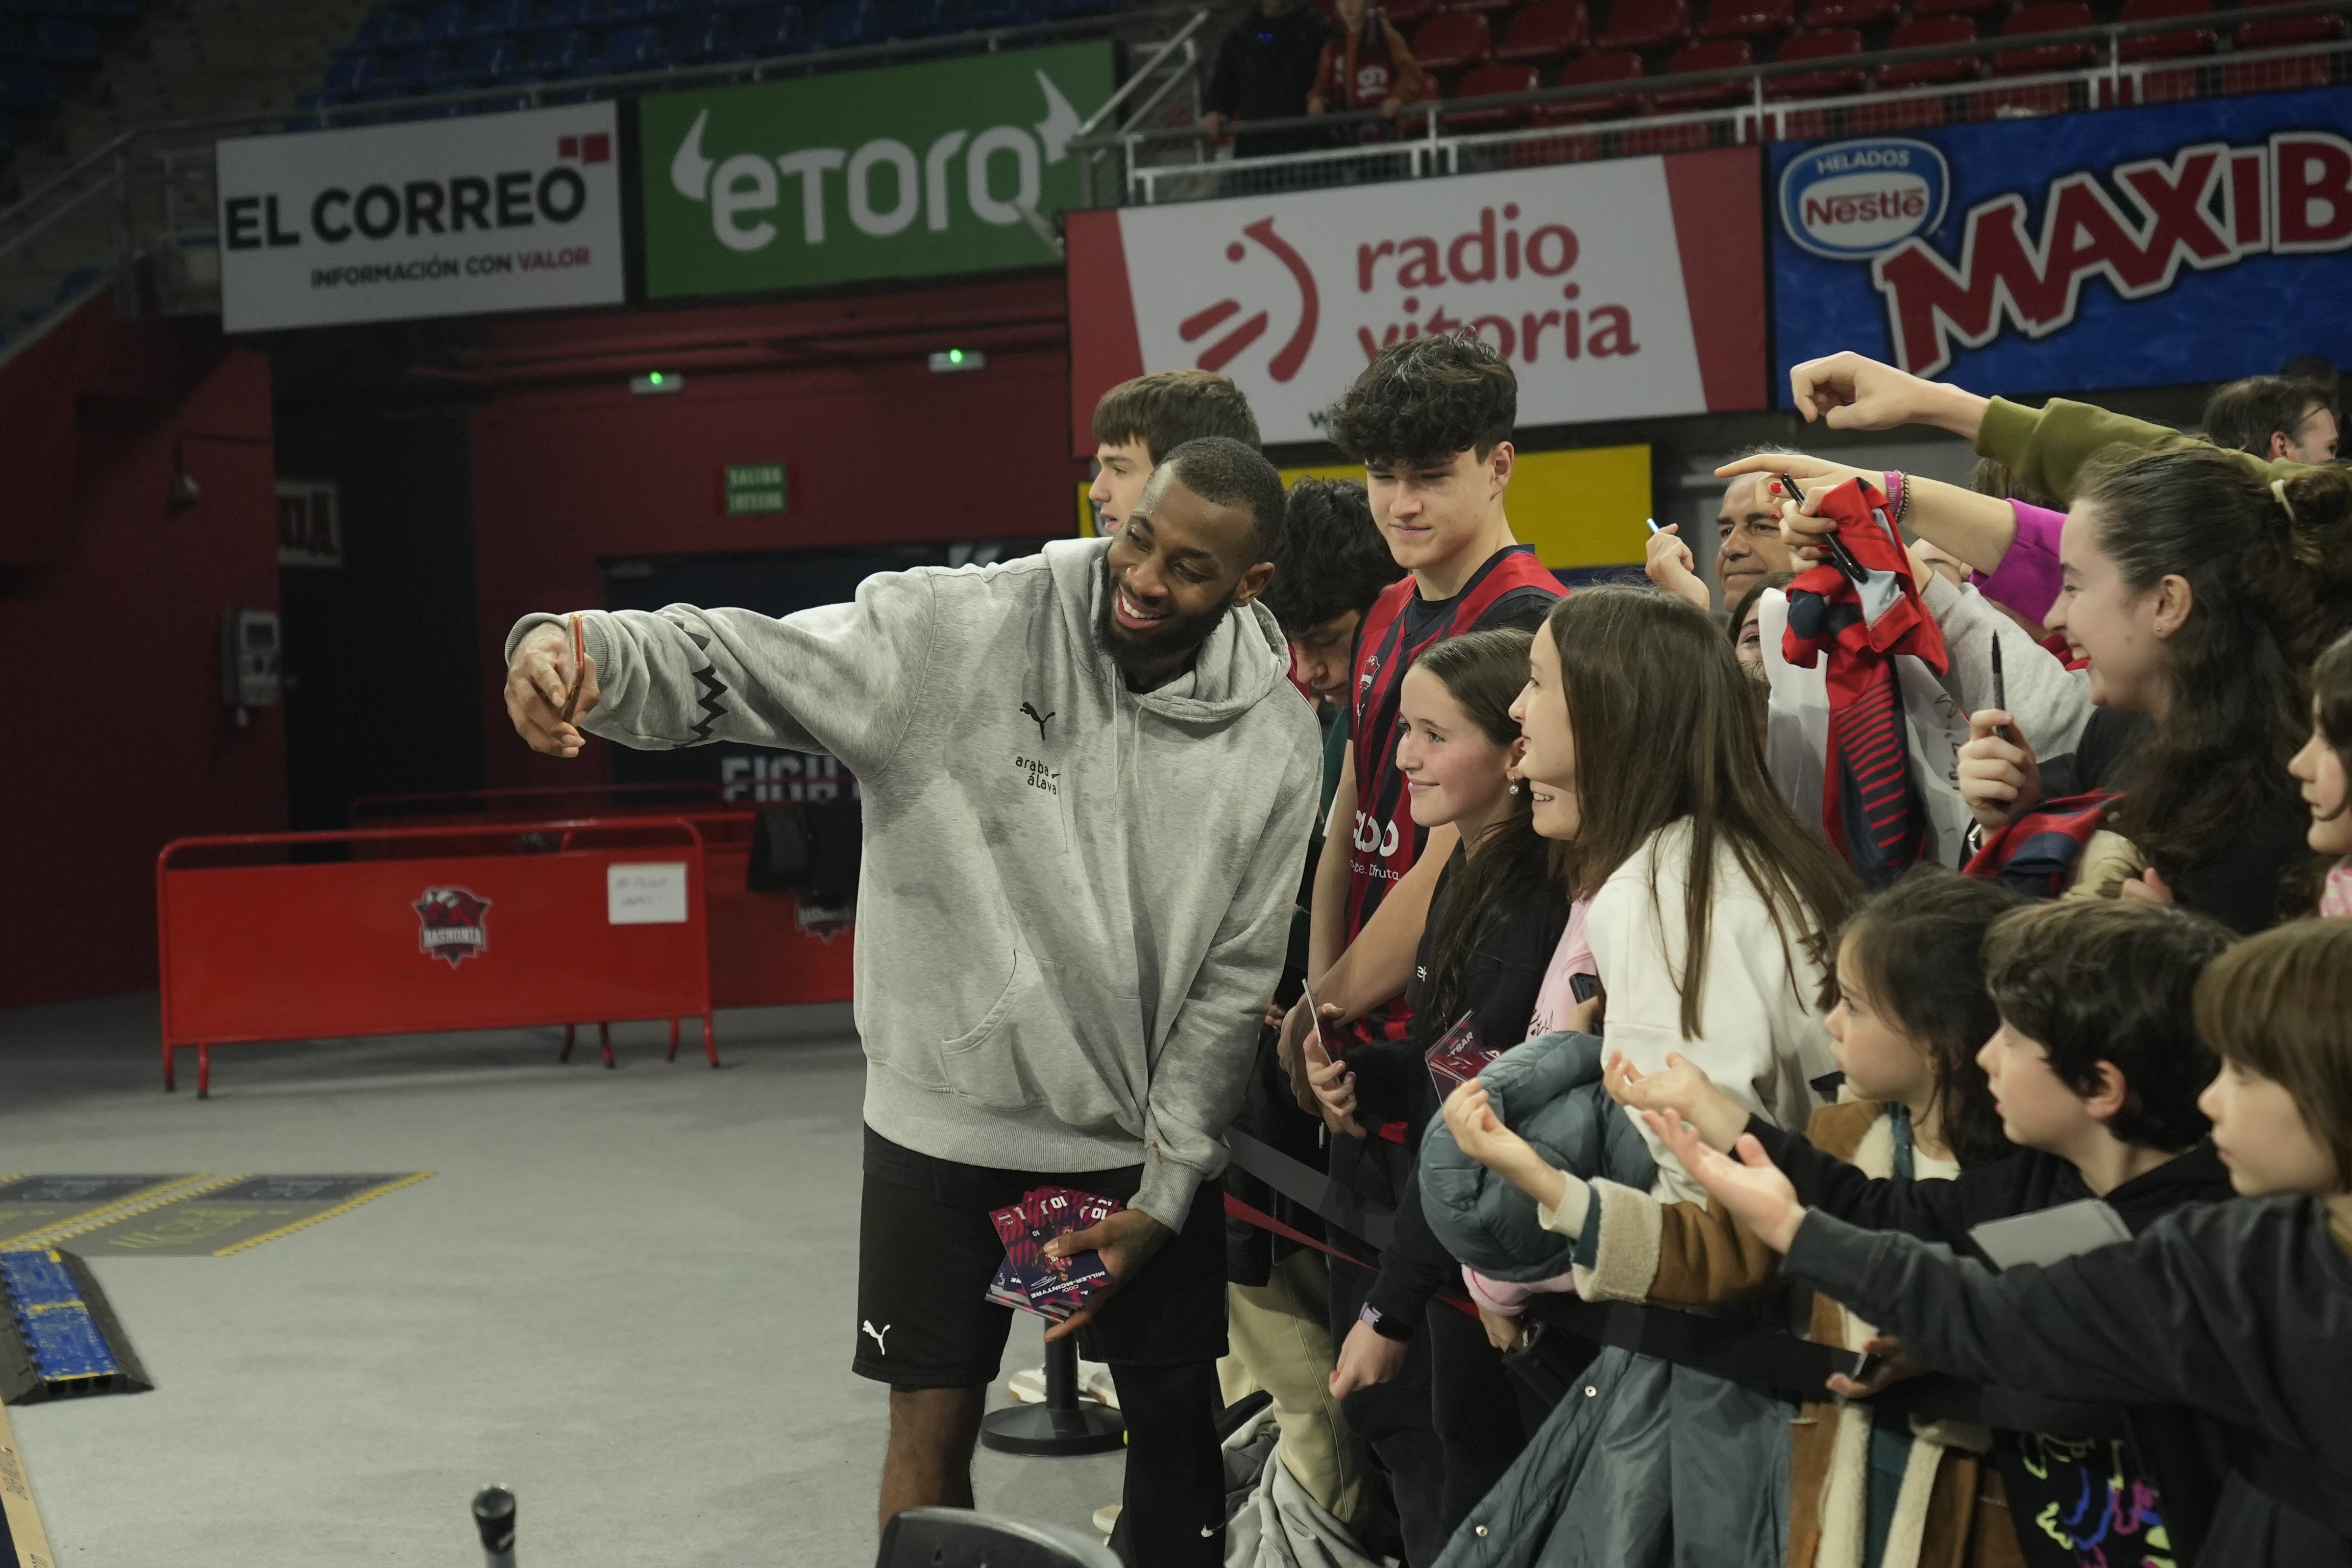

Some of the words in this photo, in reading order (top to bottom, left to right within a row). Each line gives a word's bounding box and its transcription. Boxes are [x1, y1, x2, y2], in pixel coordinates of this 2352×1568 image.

[1817, 149, 1910, 175] HELADOS
[226, 195, 300, 250] EL
[310, 166, 586, 243] CORREO
[1807, 187, 1925, 226] Nestlé
[1356, 202, 1580, 293] radio
[310, 252, 458, 288] INFORMACIÓN
[465, 254, 512, 277] CON
[517, 246, 591, 271] VALOR
[1356, 282, 1640, 362] vitoria
[729, 465, 783, 486] SALIDA
[1015, 756, 1048, 777] araba
[1027, 772, 1057, 795] álava
[1050, 1195, 1068, 1209] 10
[1090, 1207, 1108, 1220] 10
[1032, 1229, 1040, 1237] 10
[1030, 1270, 1106, 1299] MILLER-MCINTYRE
[1062, 1284, 1079, 1293] CODI
